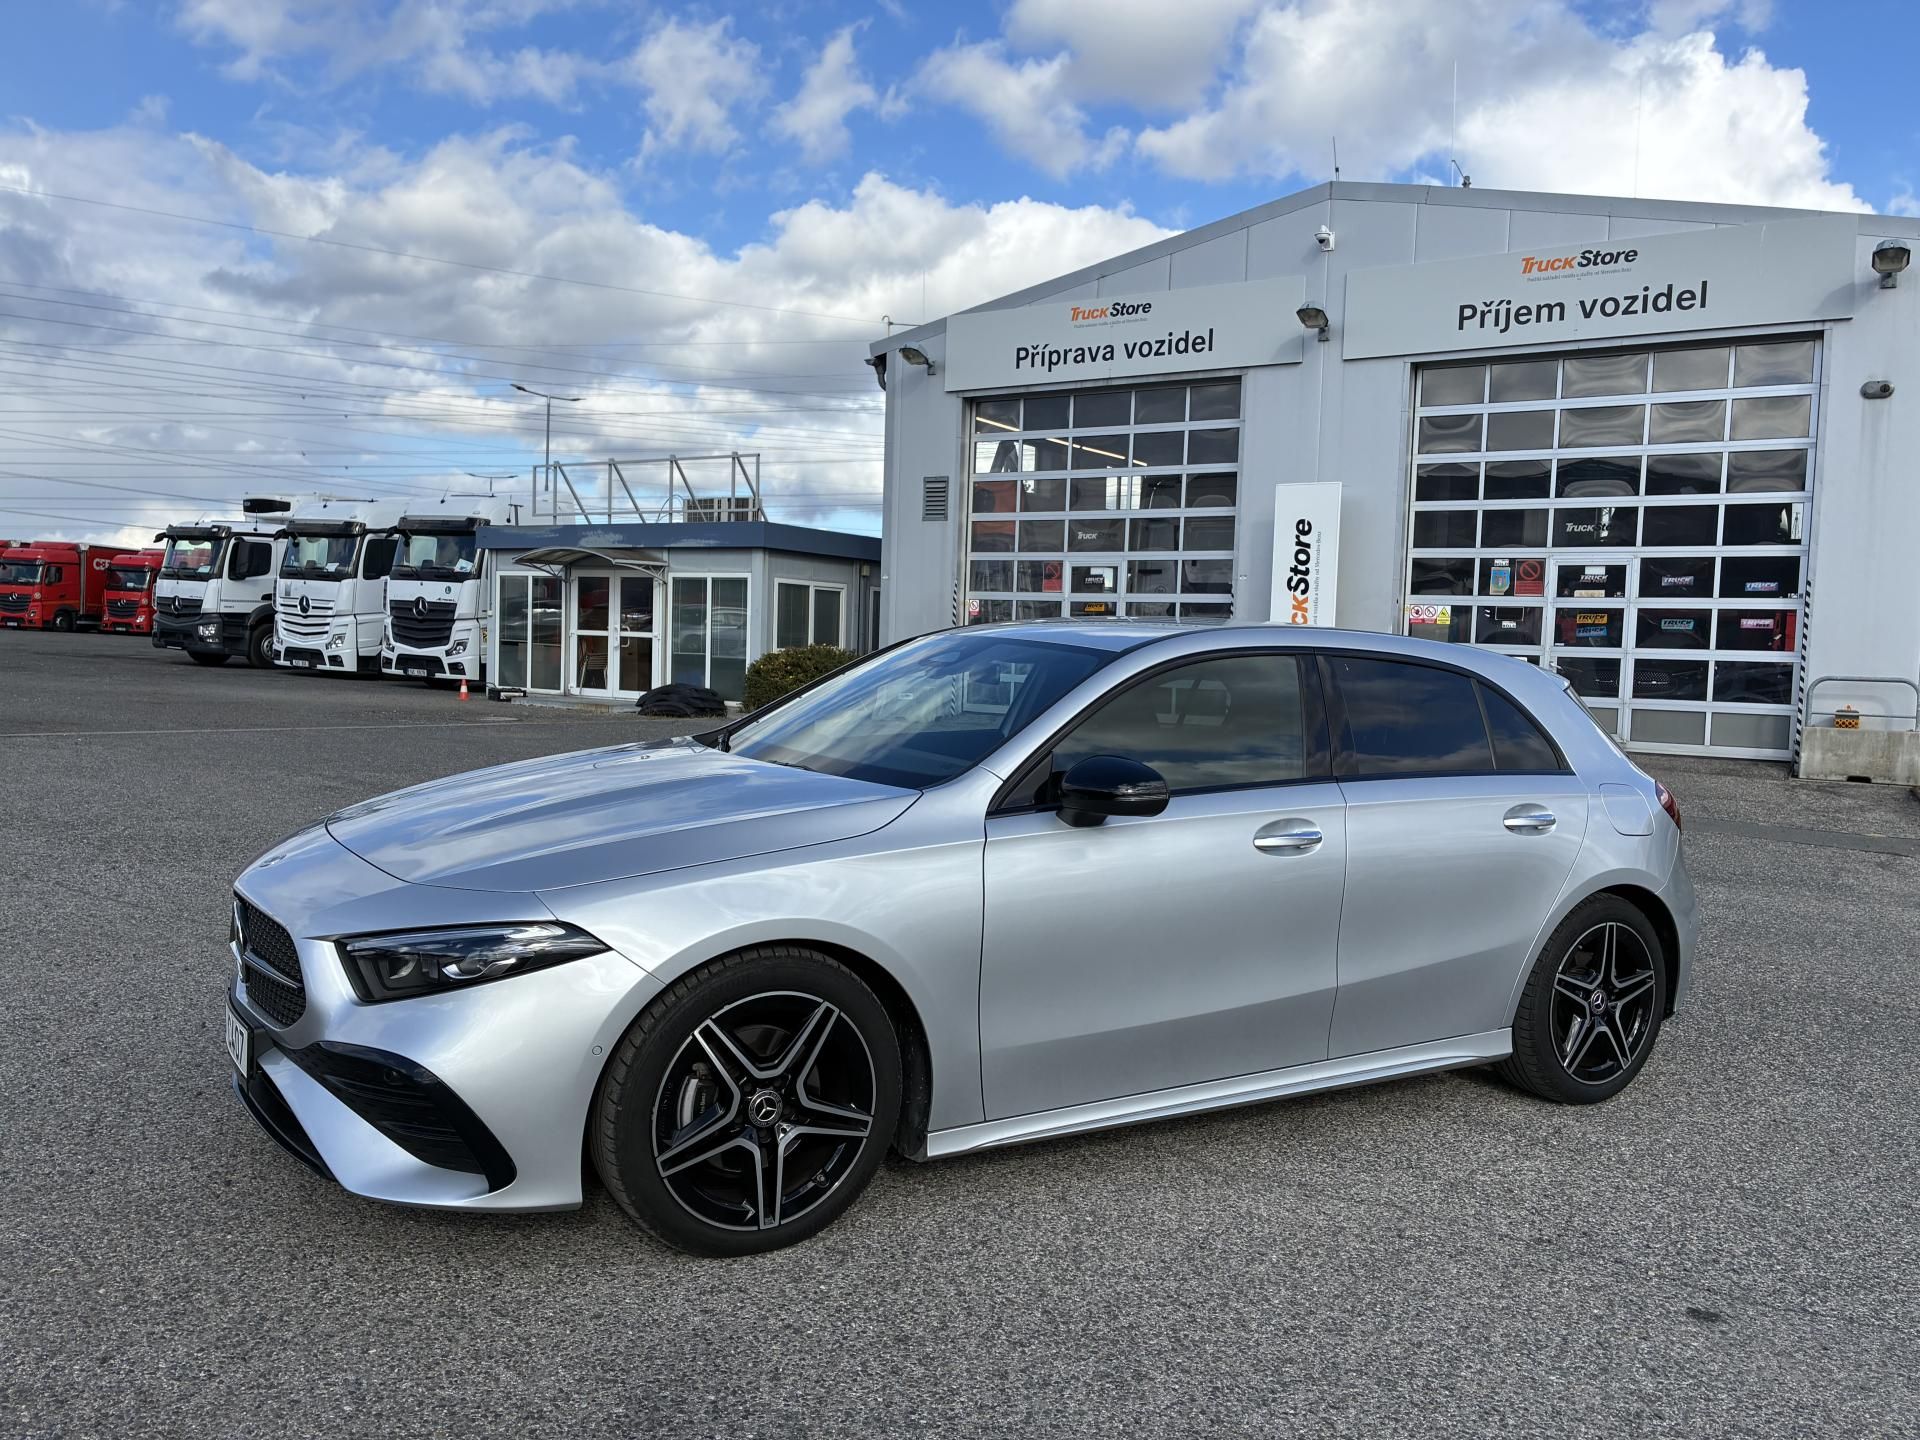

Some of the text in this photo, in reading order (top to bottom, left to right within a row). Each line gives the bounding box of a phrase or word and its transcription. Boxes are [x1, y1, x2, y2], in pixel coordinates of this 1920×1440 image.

[1458, 280, 1708, 333] Příjem vozidel
[1015, 328, 1213, 372] Příprava vozidel
